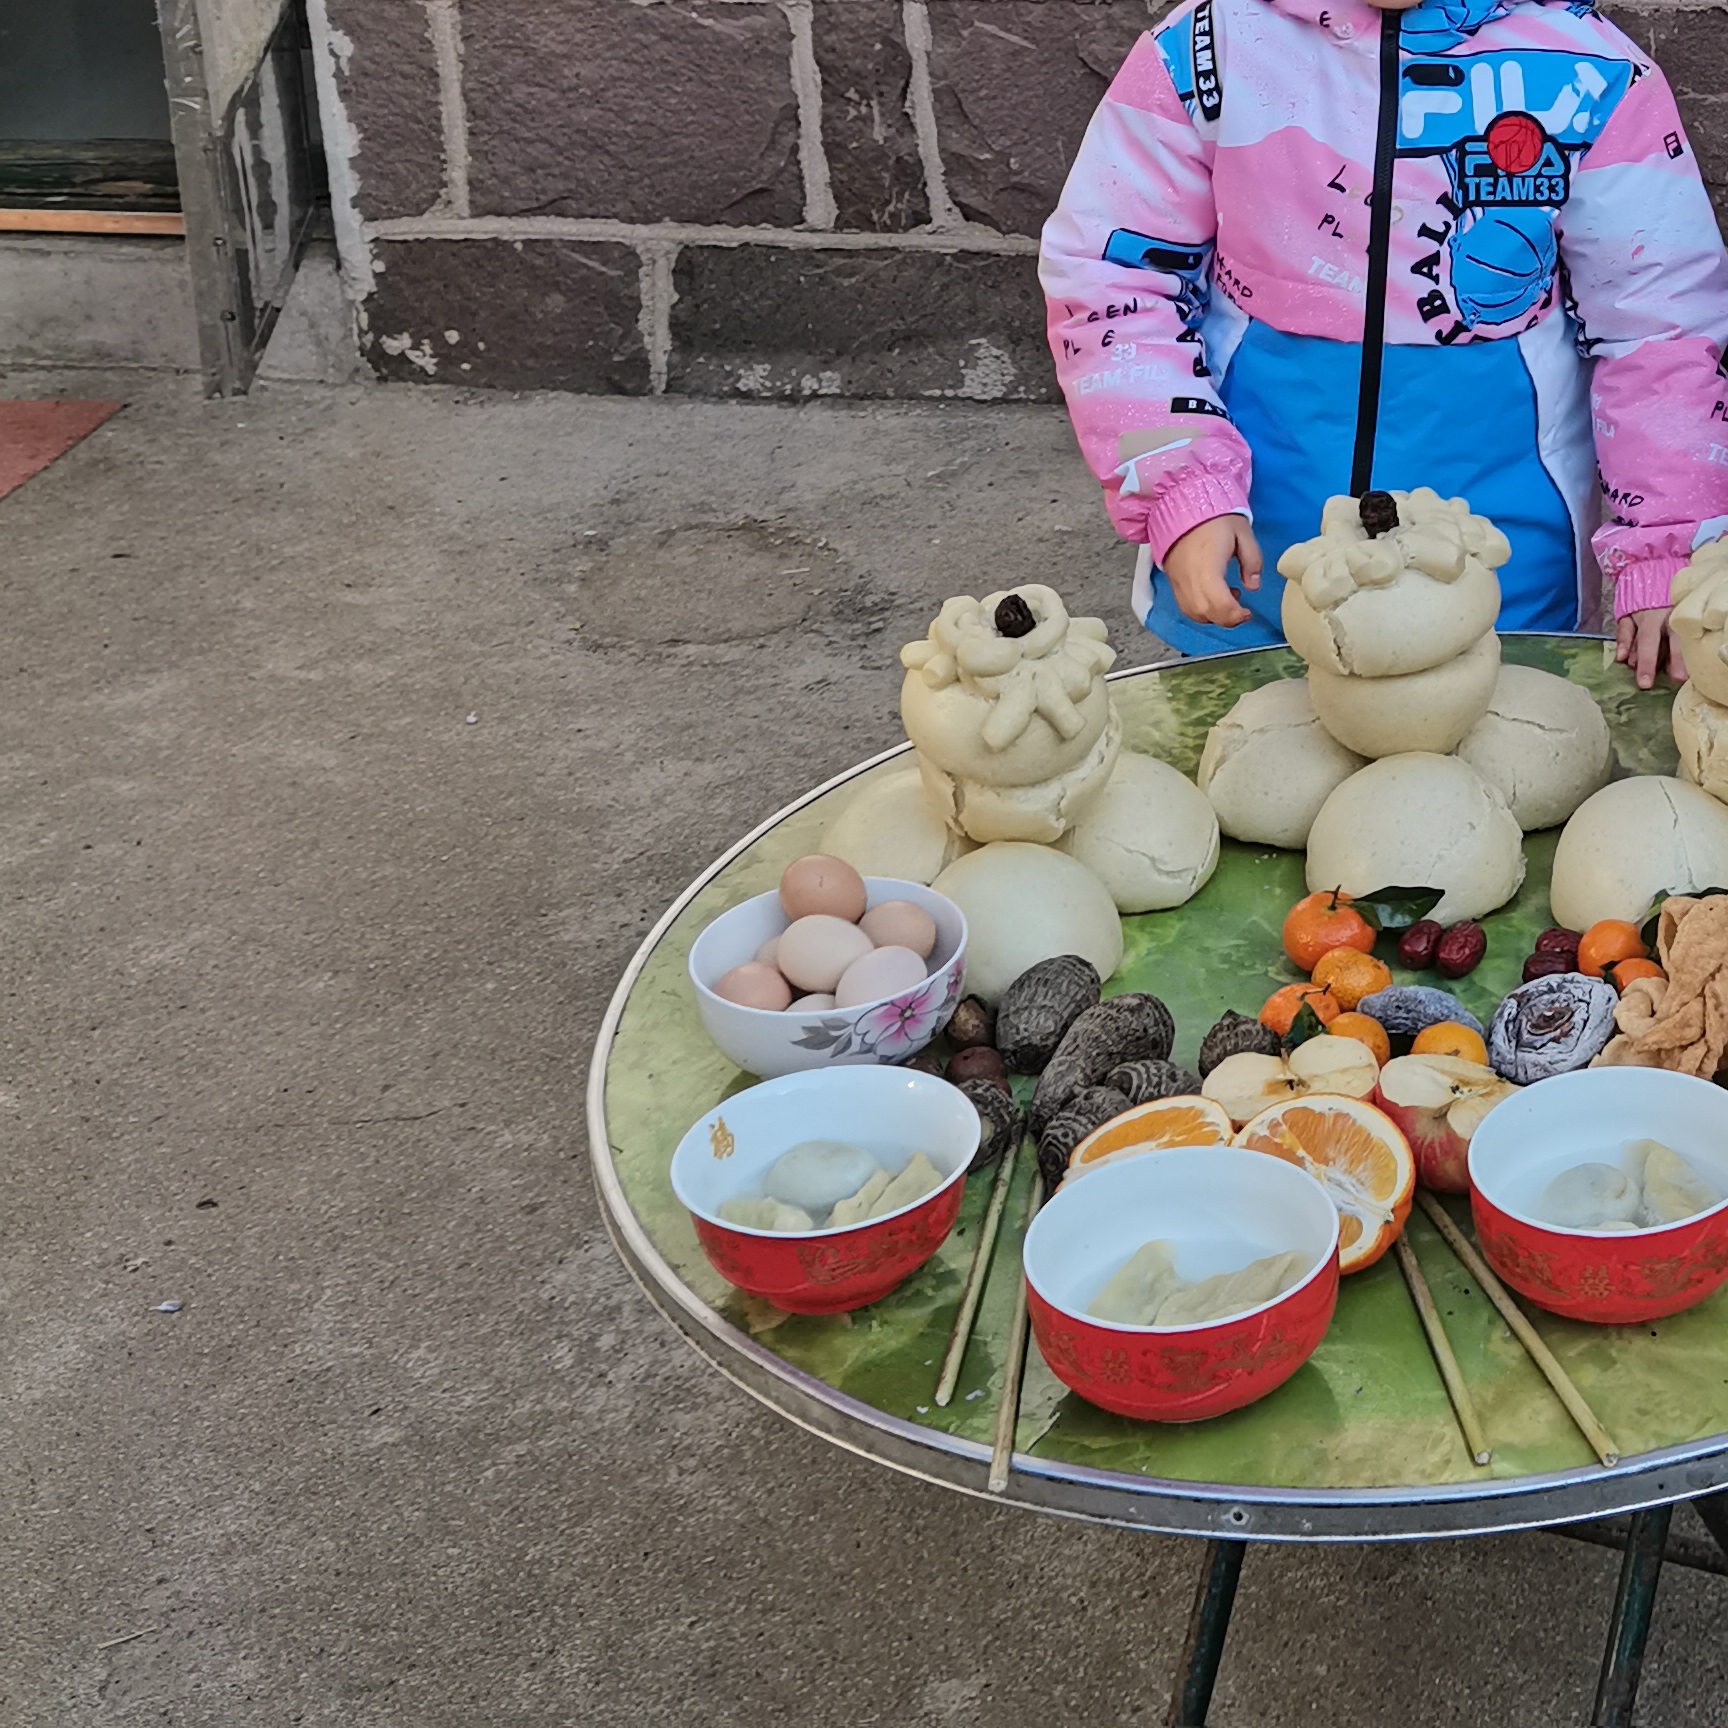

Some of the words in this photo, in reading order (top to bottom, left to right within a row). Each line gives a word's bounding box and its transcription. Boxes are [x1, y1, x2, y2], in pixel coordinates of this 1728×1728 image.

[1194, 4, 1214, 72] TEAM
[1198, 74, 1220, 108] 33
[1464, 141, 1566, 176] FA
[1464, 176, 1566, 202] TEAM33
